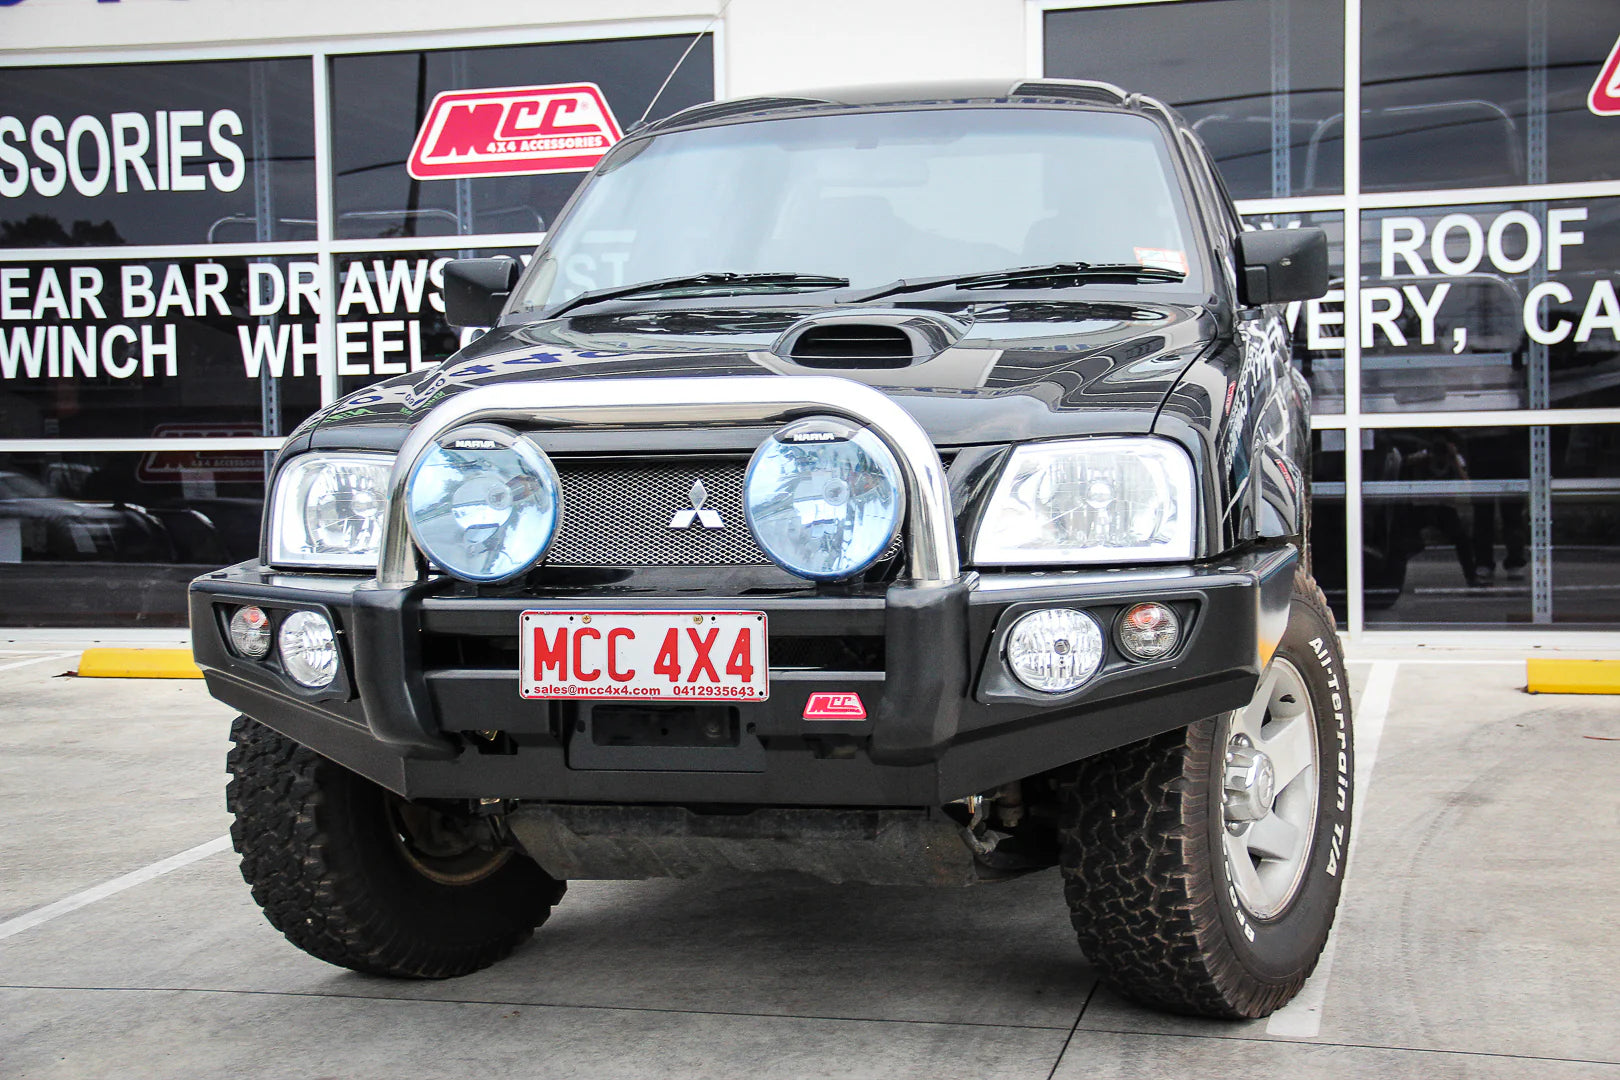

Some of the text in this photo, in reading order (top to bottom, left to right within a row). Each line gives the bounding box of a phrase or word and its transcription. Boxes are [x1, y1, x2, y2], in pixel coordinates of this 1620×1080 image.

[0, 108, 246, 199] SSORIES
[486, 135, 602, 153] 4X4 ACCESSORIES
[1380, 207, 1588, 278] ROOF
[1, 262, 105, 320] EAR
[121, 263, 229, 318] BAR
[0, 323, 177, 379] WINCH
[237, 319, 442, 378] WHEEL
[455, 440, 496, 448] NARVA
[793, 432, 835, 441] NARVA
[533, 627, 754, 683] MCC 4X4
[533, 684, 755, 697] sales@mcc4x4.com 0412935643
[1308, 637, 1348, 877] All-Terrain T/A
